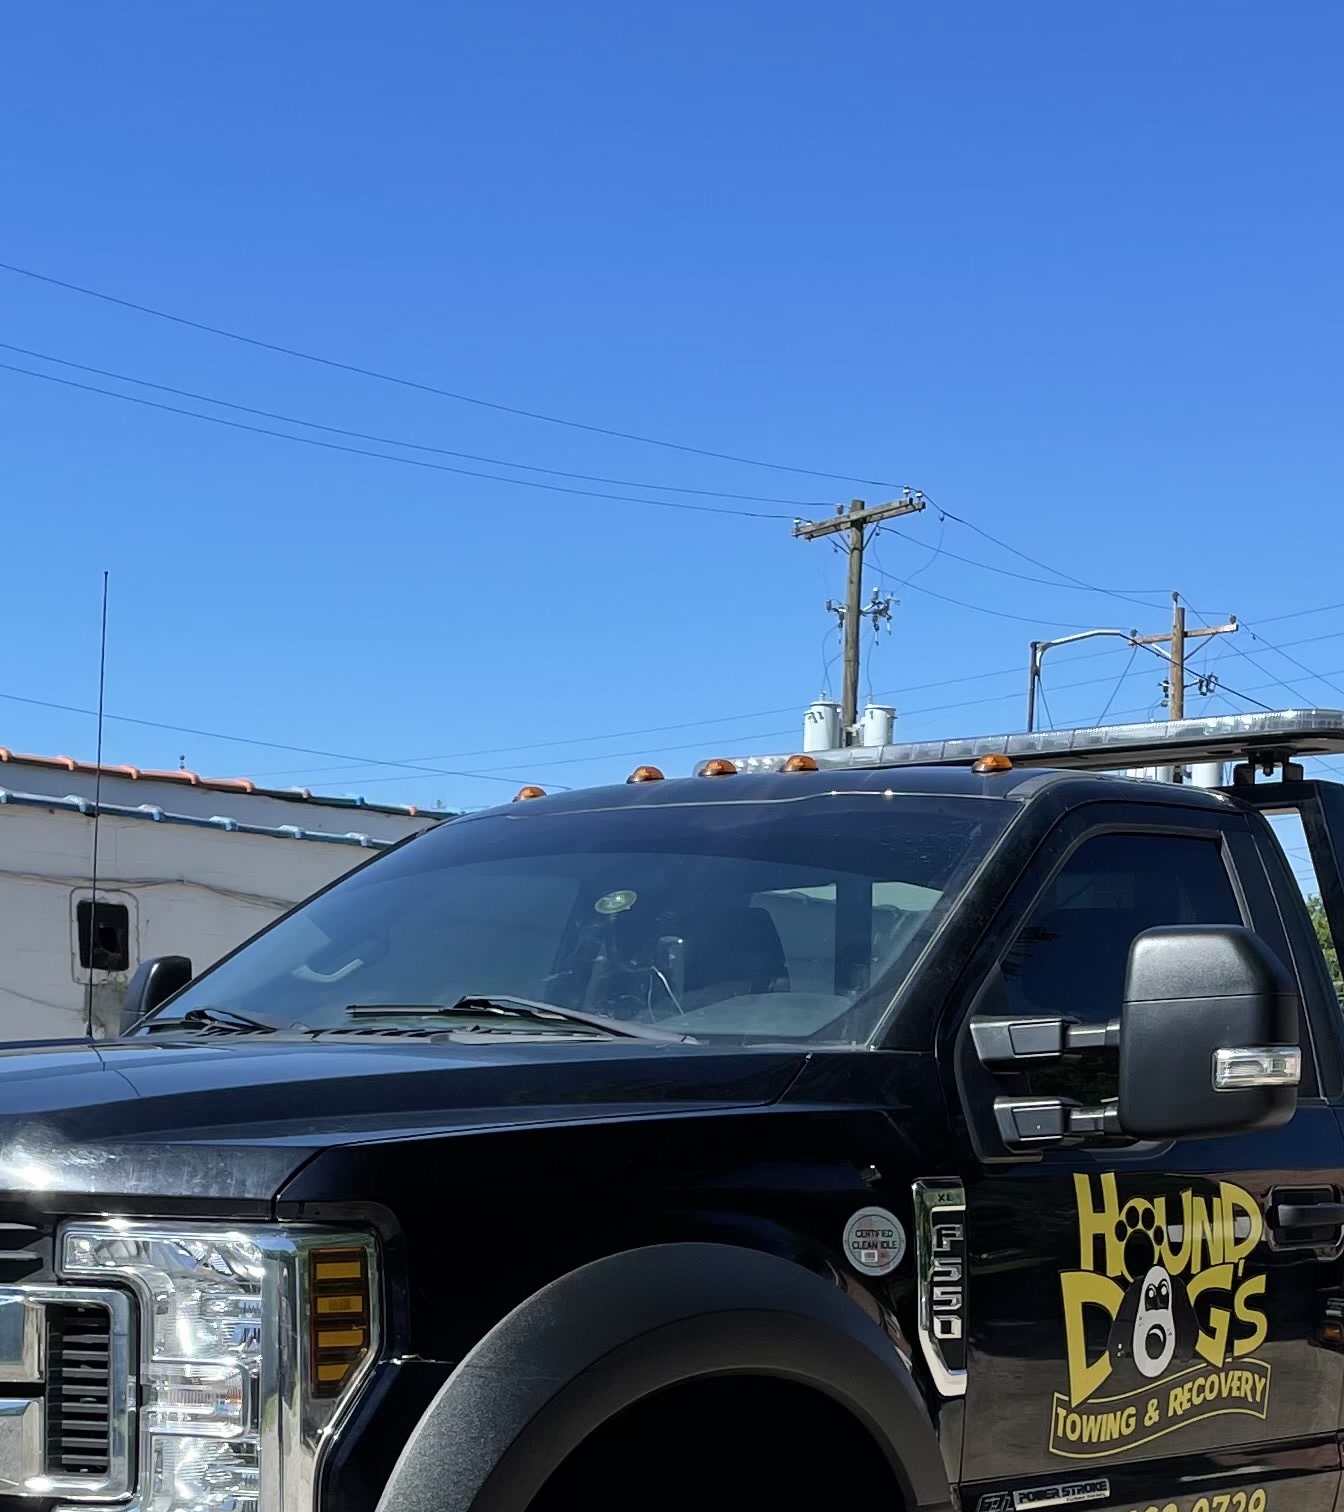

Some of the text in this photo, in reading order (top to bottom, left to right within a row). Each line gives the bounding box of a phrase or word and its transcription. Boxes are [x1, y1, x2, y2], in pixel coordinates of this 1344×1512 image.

[937, 1193, 953, 1202] XL
[1073, 1171, 1264, 1284] HOUND
[855, 1229, 894, 1238] CERTIFIED
[852, 1240, 898, 1250] CLEAN IDLE
[1056, 1370, 1267, 1443] TOWING & RECOVERY
